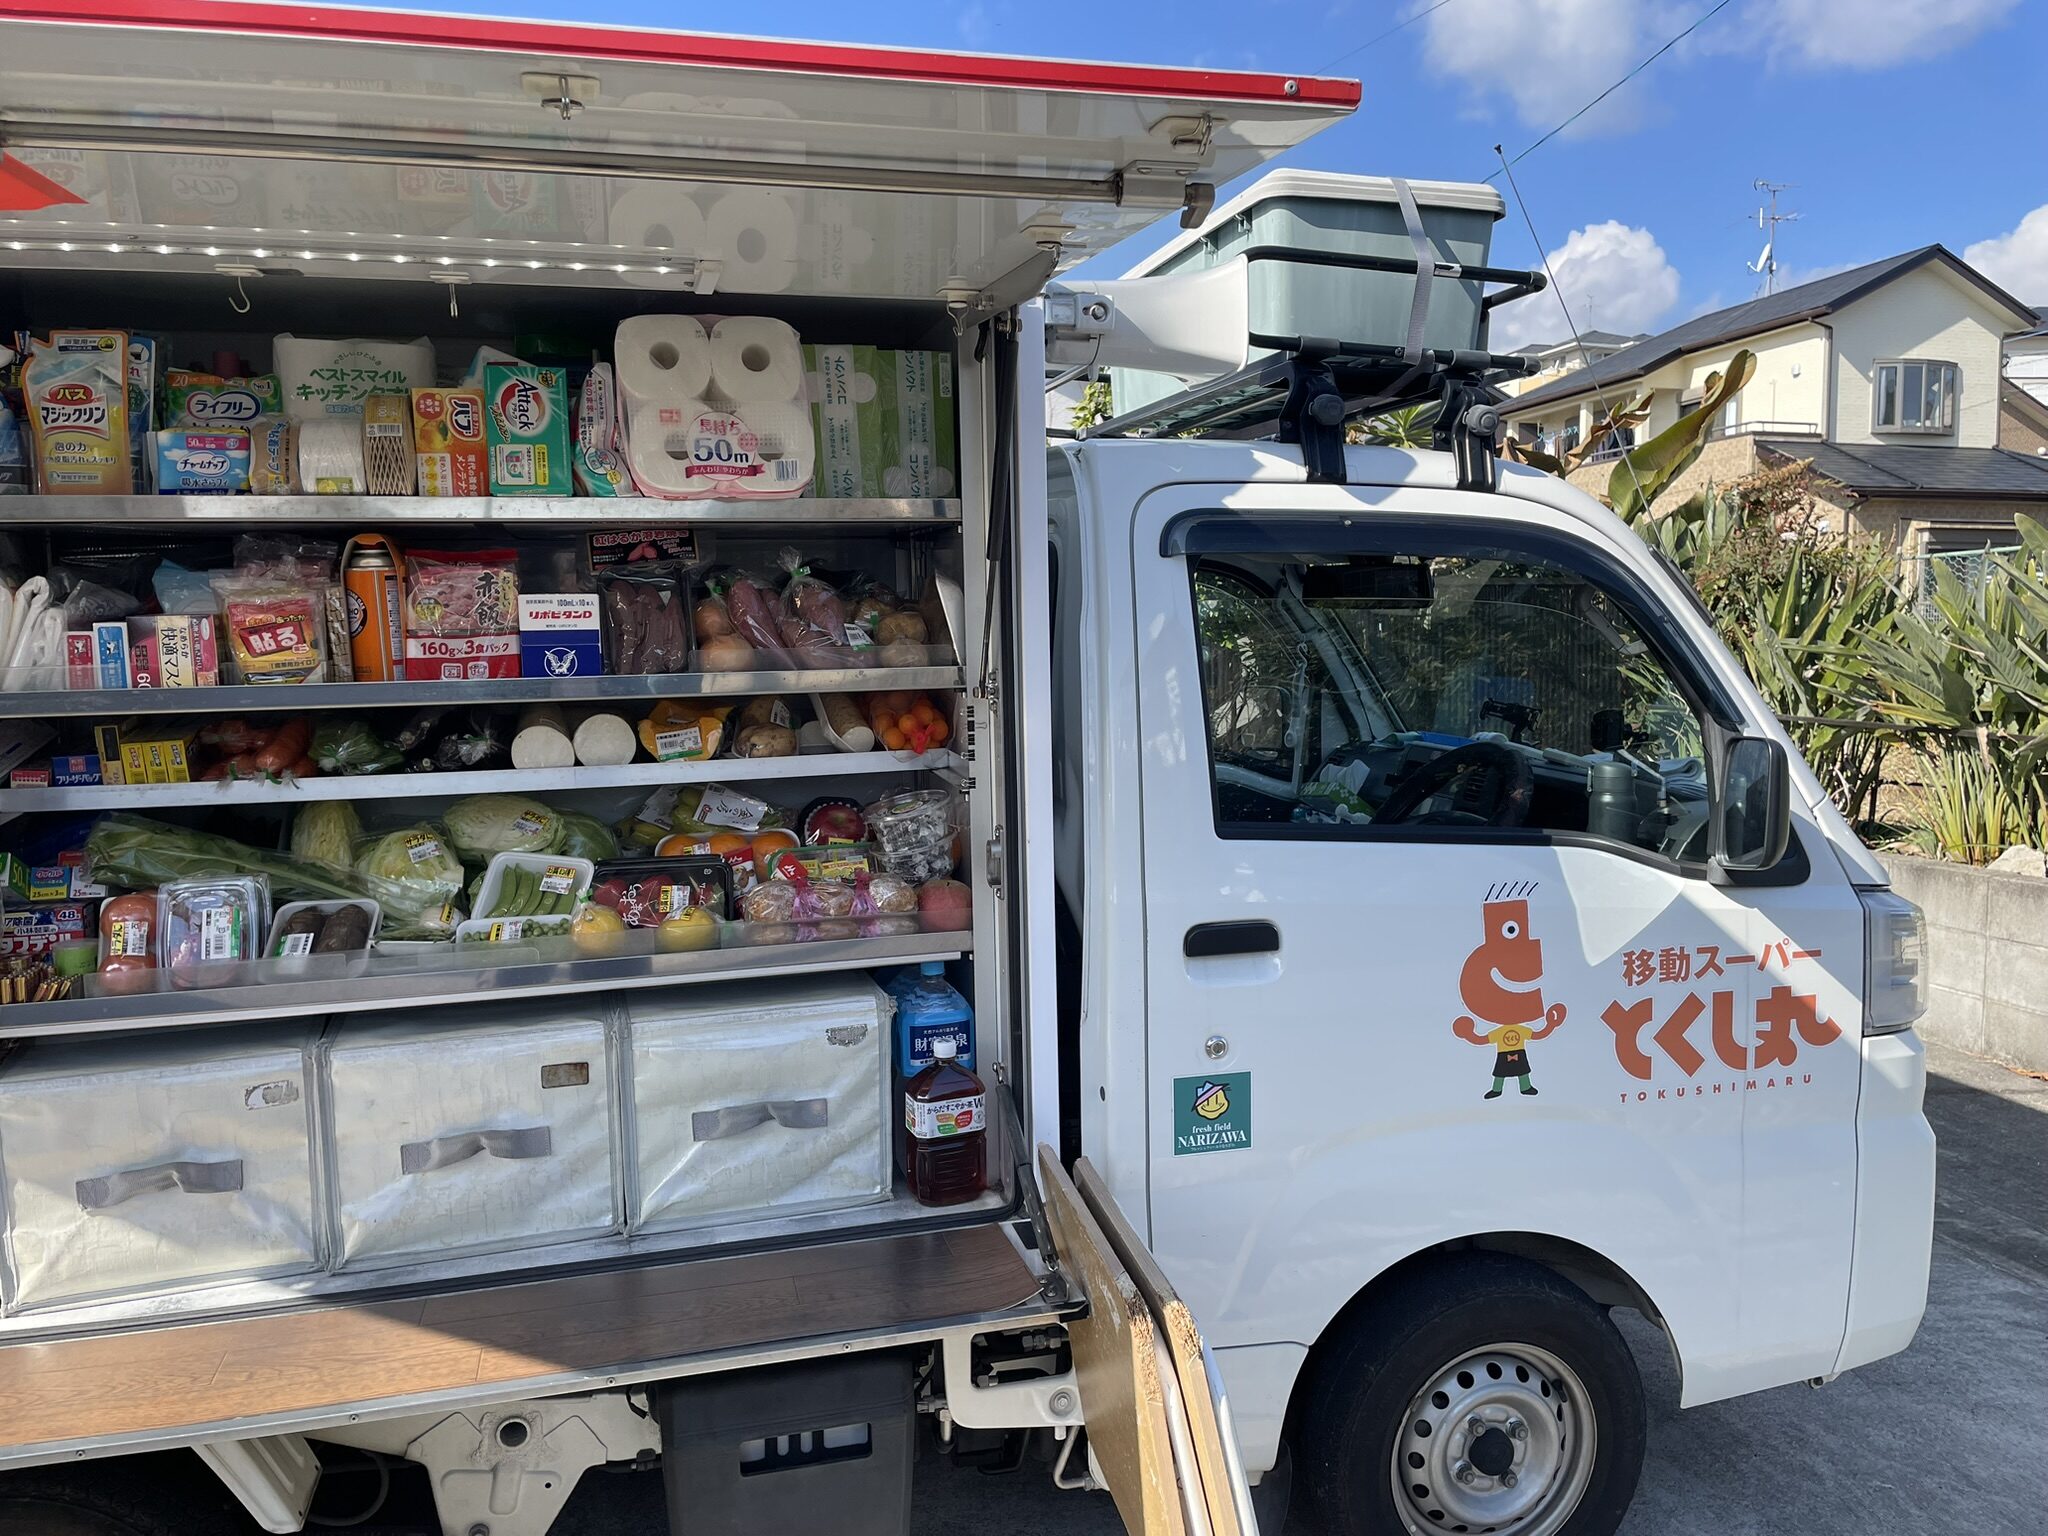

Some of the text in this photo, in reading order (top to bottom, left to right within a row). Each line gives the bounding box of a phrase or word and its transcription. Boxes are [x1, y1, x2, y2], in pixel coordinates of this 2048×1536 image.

[309, 368, 407, 384] ベストスマイル
[834, 356, 847, 405] コンパクト
[56, 388, 88, 401] バス
[515, 378, 539, 431] Attack
[41, 405, 107, 425] マジックリン
[194, 399, 254, 416] ライフリー
[452, 399, 472, 436] バブ
[699, 419, 740, 435] 長持ち
[54, 441, 87, 453] 泡の力
[693, 438, 750, 464] 50m
[179, 455, 229, 471] チャームナップ
[474, 571, 504, 628] 赤飯
[529, 610, 593, 621] リポビタンD
[180, 627, 190, 659] なめらか
[248, 626, 299, 654] 貼る
[420, 640, 510, 657] 160g×3食パック
[1622, 937, 1822, 987] 移動スーパー
[1599, 985, 1843, 1081] とくし丸
[1620, 1073, 1813, 1104] TOKUSHIMARU
[926, 1097, 984, 1115] からだすこやか茶W
[1192, 1122, 1232, 1134] fresh field
[1176, 1129, 1247, 1149] NARIZAWA
